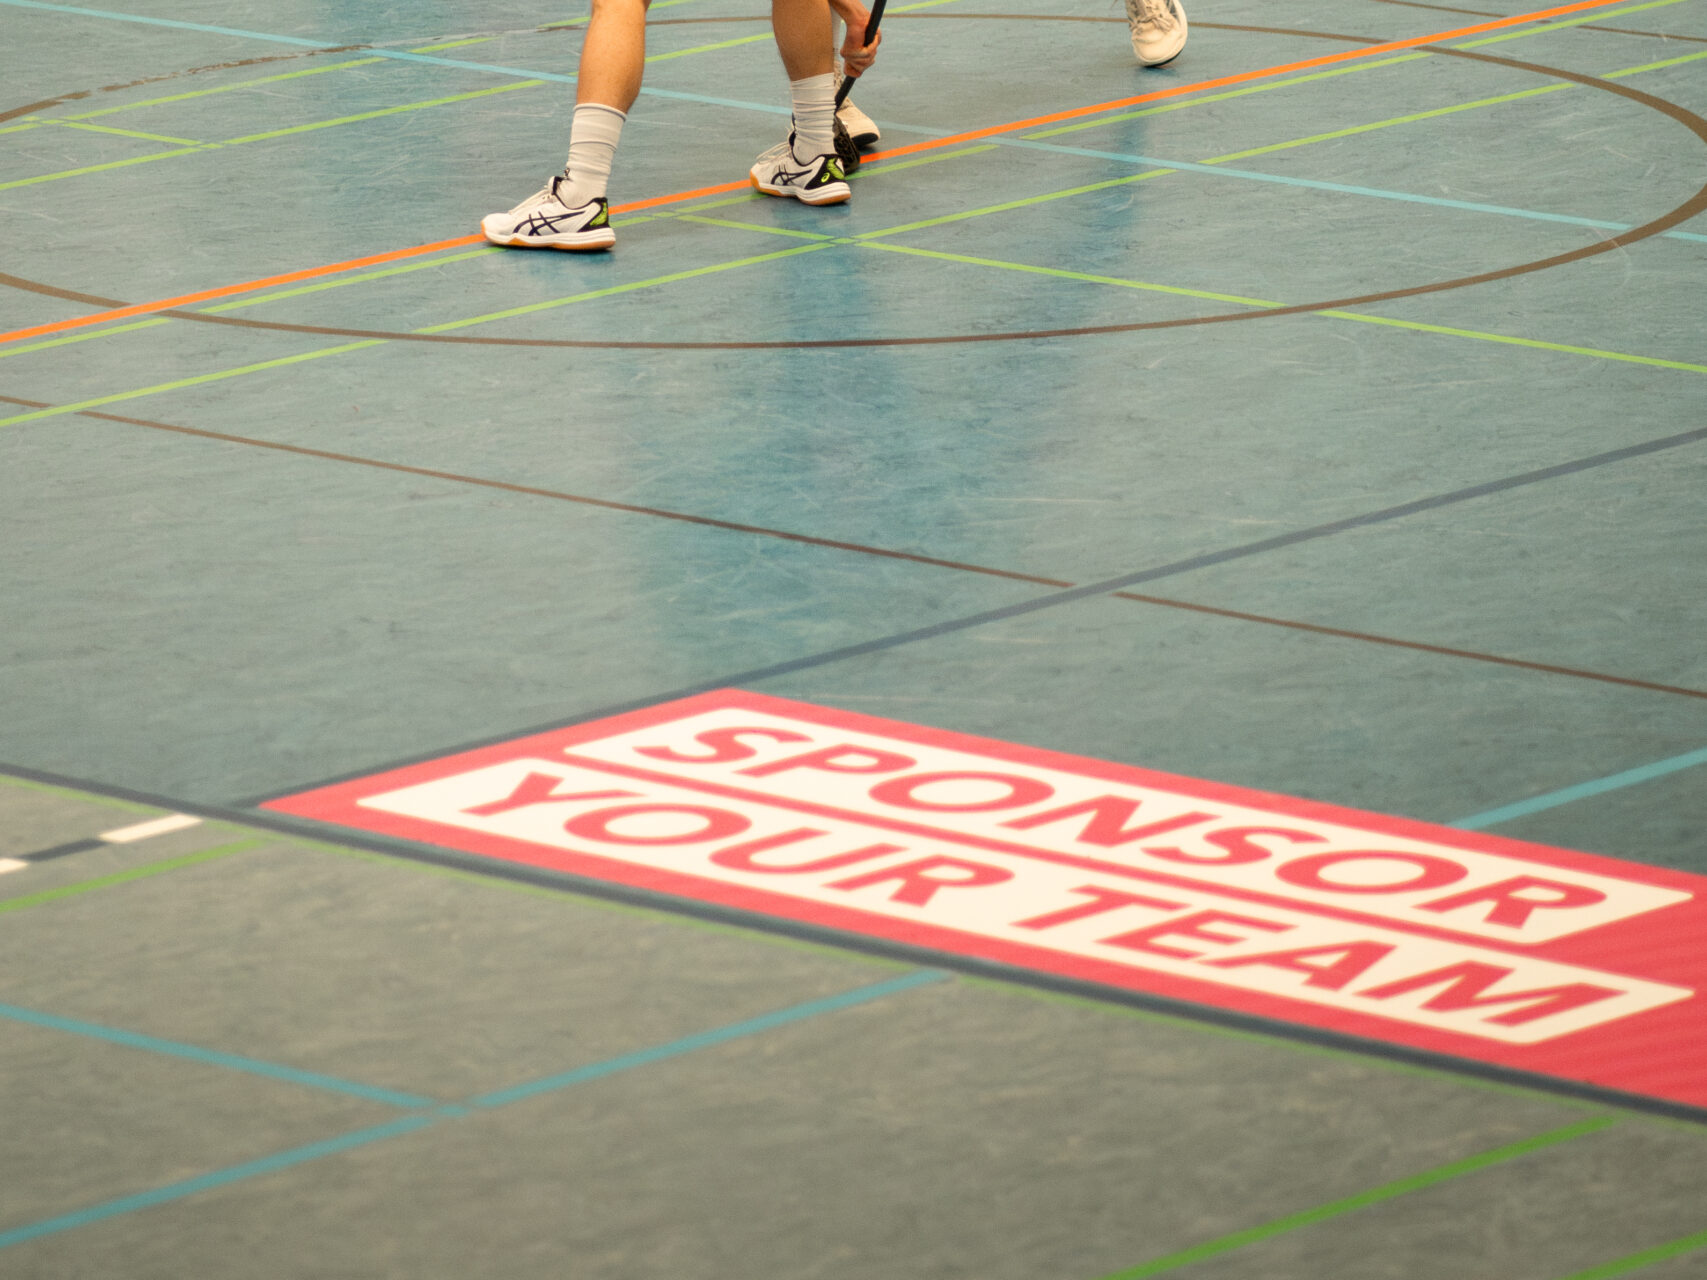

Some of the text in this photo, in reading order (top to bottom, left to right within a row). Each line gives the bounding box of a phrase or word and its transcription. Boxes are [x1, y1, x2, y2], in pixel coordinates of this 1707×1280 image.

[459, 772, 1628, 1028] YOUR TEAM
[632, 727, 1607, 930] SPONSOR
